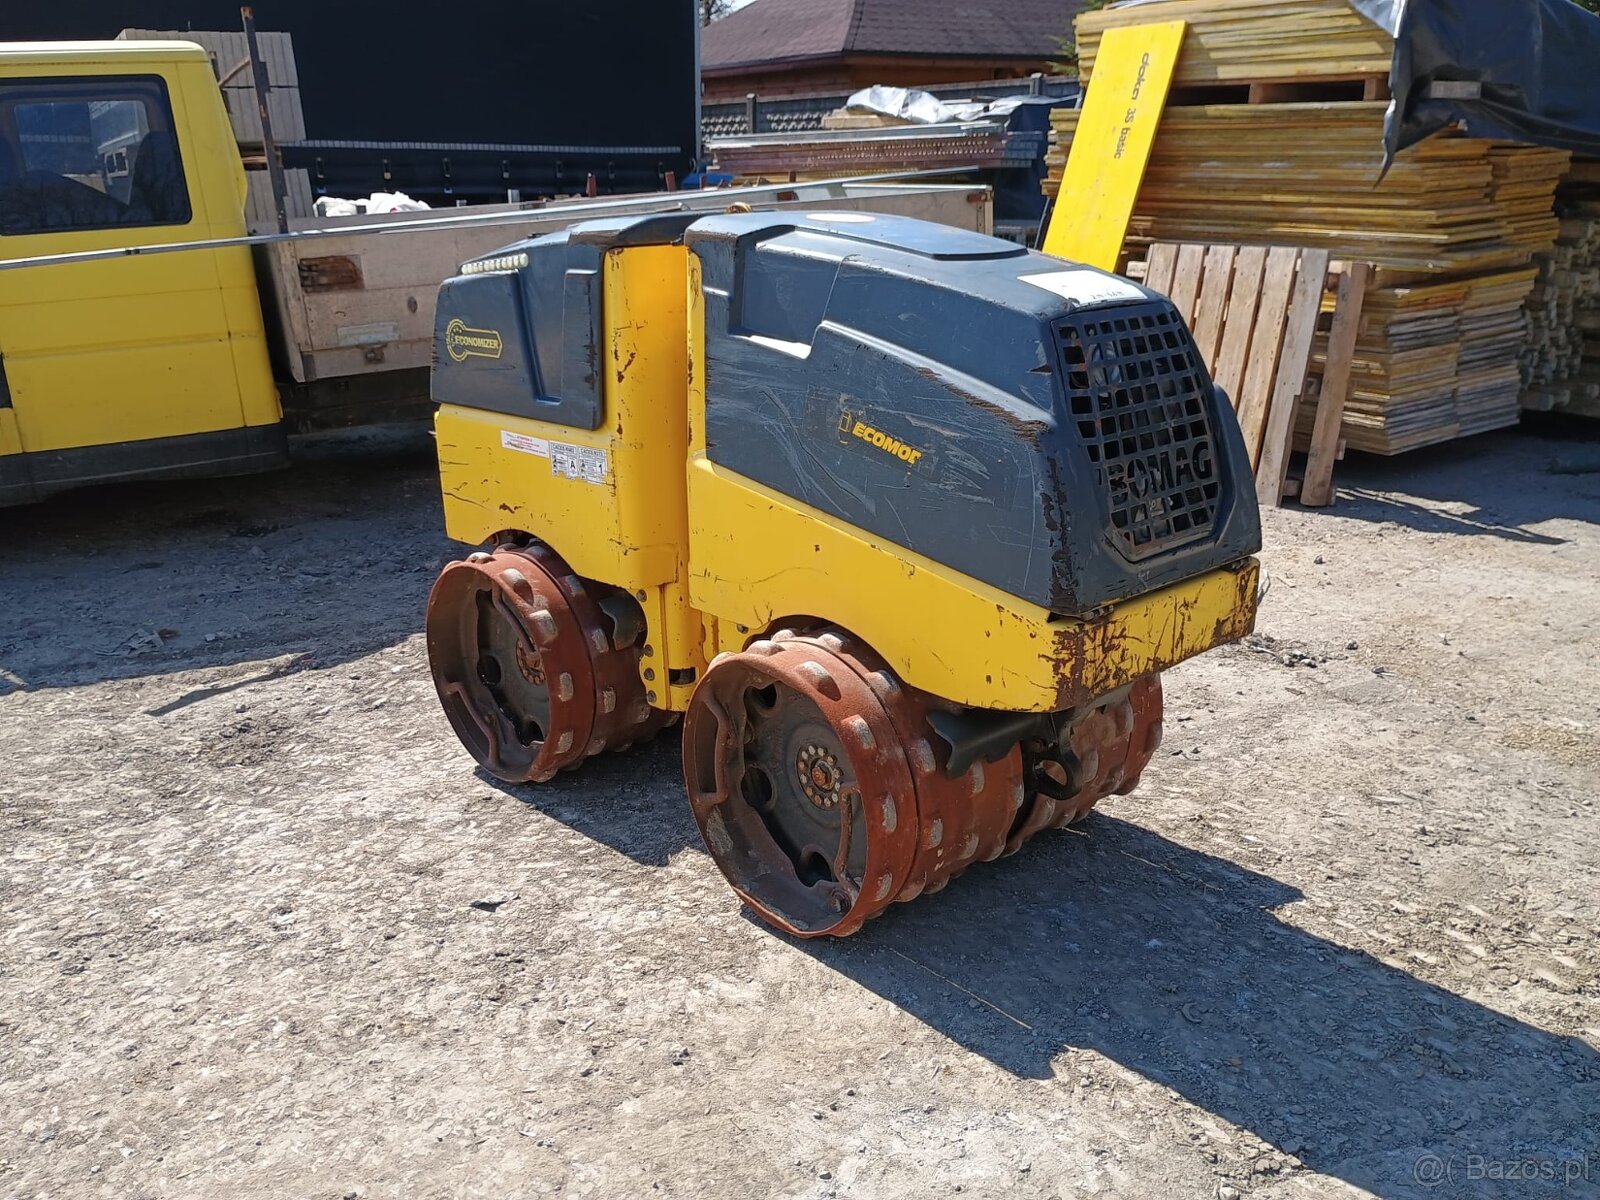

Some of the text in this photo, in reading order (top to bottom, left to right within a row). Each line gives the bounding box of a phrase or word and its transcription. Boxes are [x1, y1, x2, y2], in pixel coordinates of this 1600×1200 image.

[1131, 52, 1150, 101] doka
[1114, 127, 1131, 159] basic
[454, 335, 499, 349] ECONOMIZER
[1106, 440, 1213, 506] BOMAG
